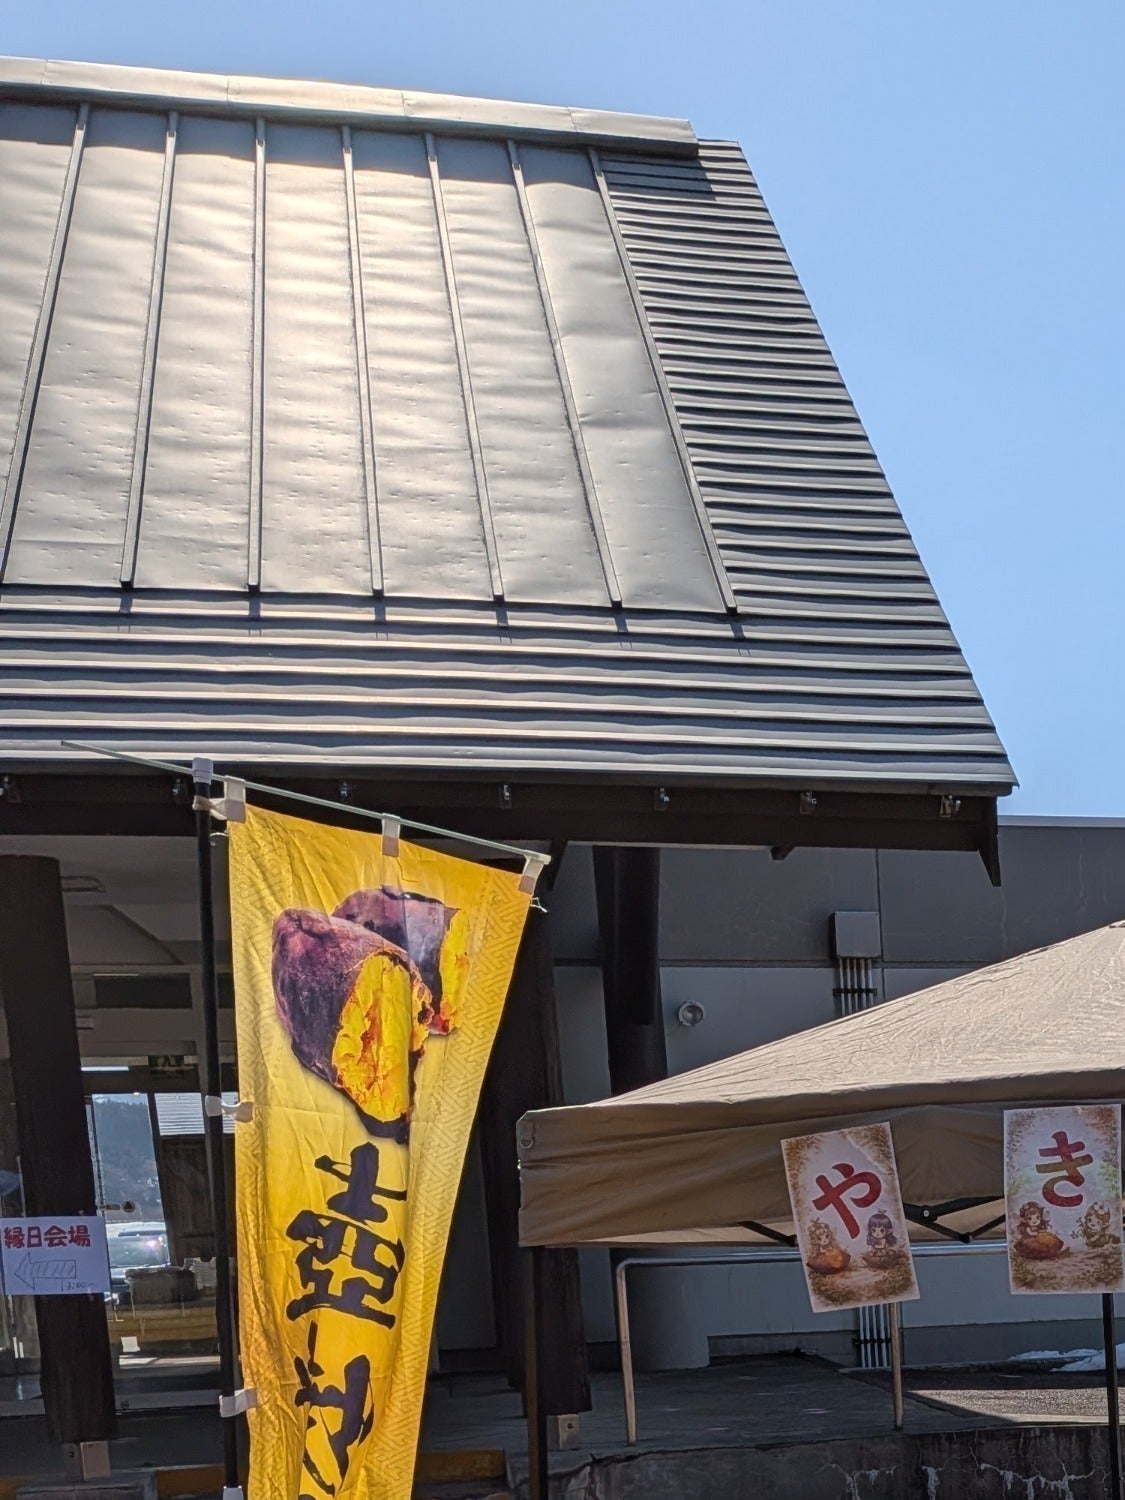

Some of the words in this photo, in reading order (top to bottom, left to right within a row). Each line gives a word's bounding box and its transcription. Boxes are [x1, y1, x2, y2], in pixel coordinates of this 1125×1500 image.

[812, 1162, 882, 1240] や
[1035, 1130, 1094, 1207] き
[3, 1225, 91, 1249] 縁日会場
